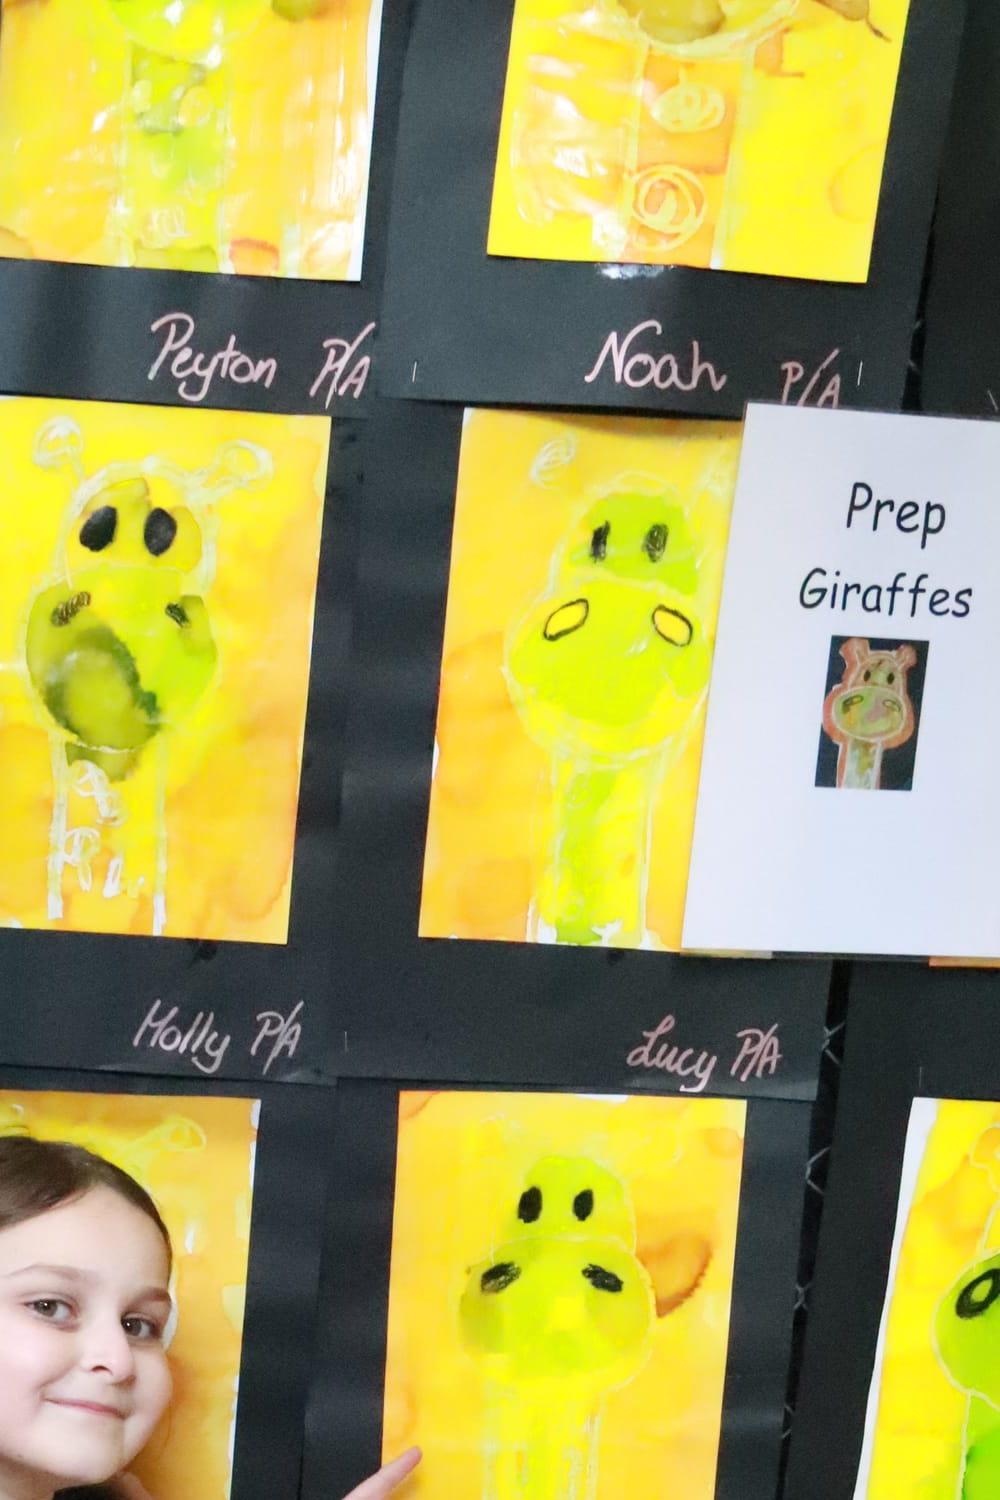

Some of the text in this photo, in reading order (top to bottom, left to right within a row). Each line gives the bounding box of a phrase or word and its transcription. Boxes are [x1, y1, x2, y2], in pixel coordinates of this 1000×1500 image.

[148, 312, 377, 410] Peyton P/A
[584, 319, 840, 408] Noah P/A
[846, 482, 946, 550] Prep
[799, 567, 973, 618] Giraffes
[250, 1000, 304, 1076] P/A
[626, 1014, 783, 1093] Lucy P/A
